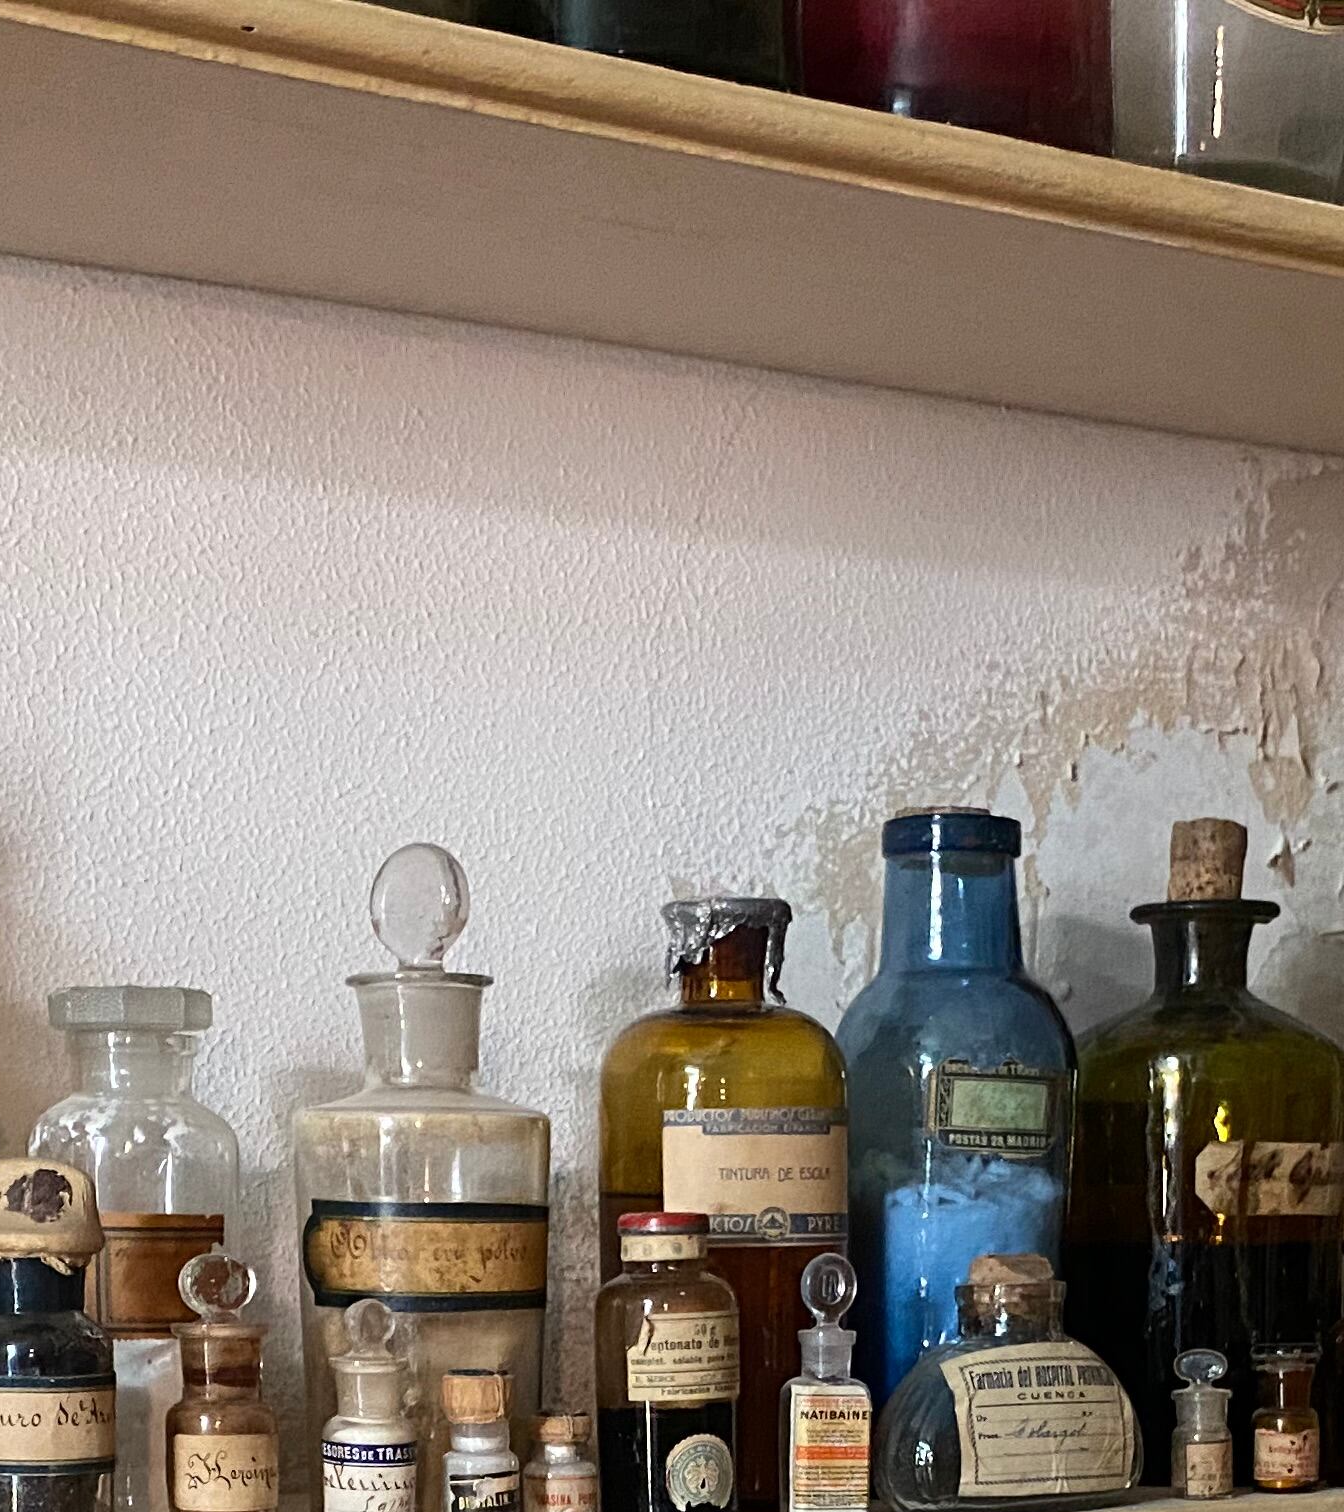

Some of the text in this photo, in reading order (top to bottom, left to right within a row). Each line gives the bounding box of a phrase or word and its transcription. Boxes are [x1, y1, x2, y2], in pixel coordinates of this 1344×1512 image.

[1006, 1135, 1047, 1148] MADRID
[719, 1167, 770, 1181] TINTURA
[777, 1167, 793, 1182] DE
[651, 1338, 702, 1353] eptonato
[708, 1336, 720, 1348] de
[969, 1367, 1014, 1391] Farmacia
[1017, 1365, 1032, 1389] del
[1035, 1364, 1075, 1387] HOSPITAL
[1017, 1391, 1087, 1401] CUENCA
[800, 1410, 869, 1420] NATIBAINE
